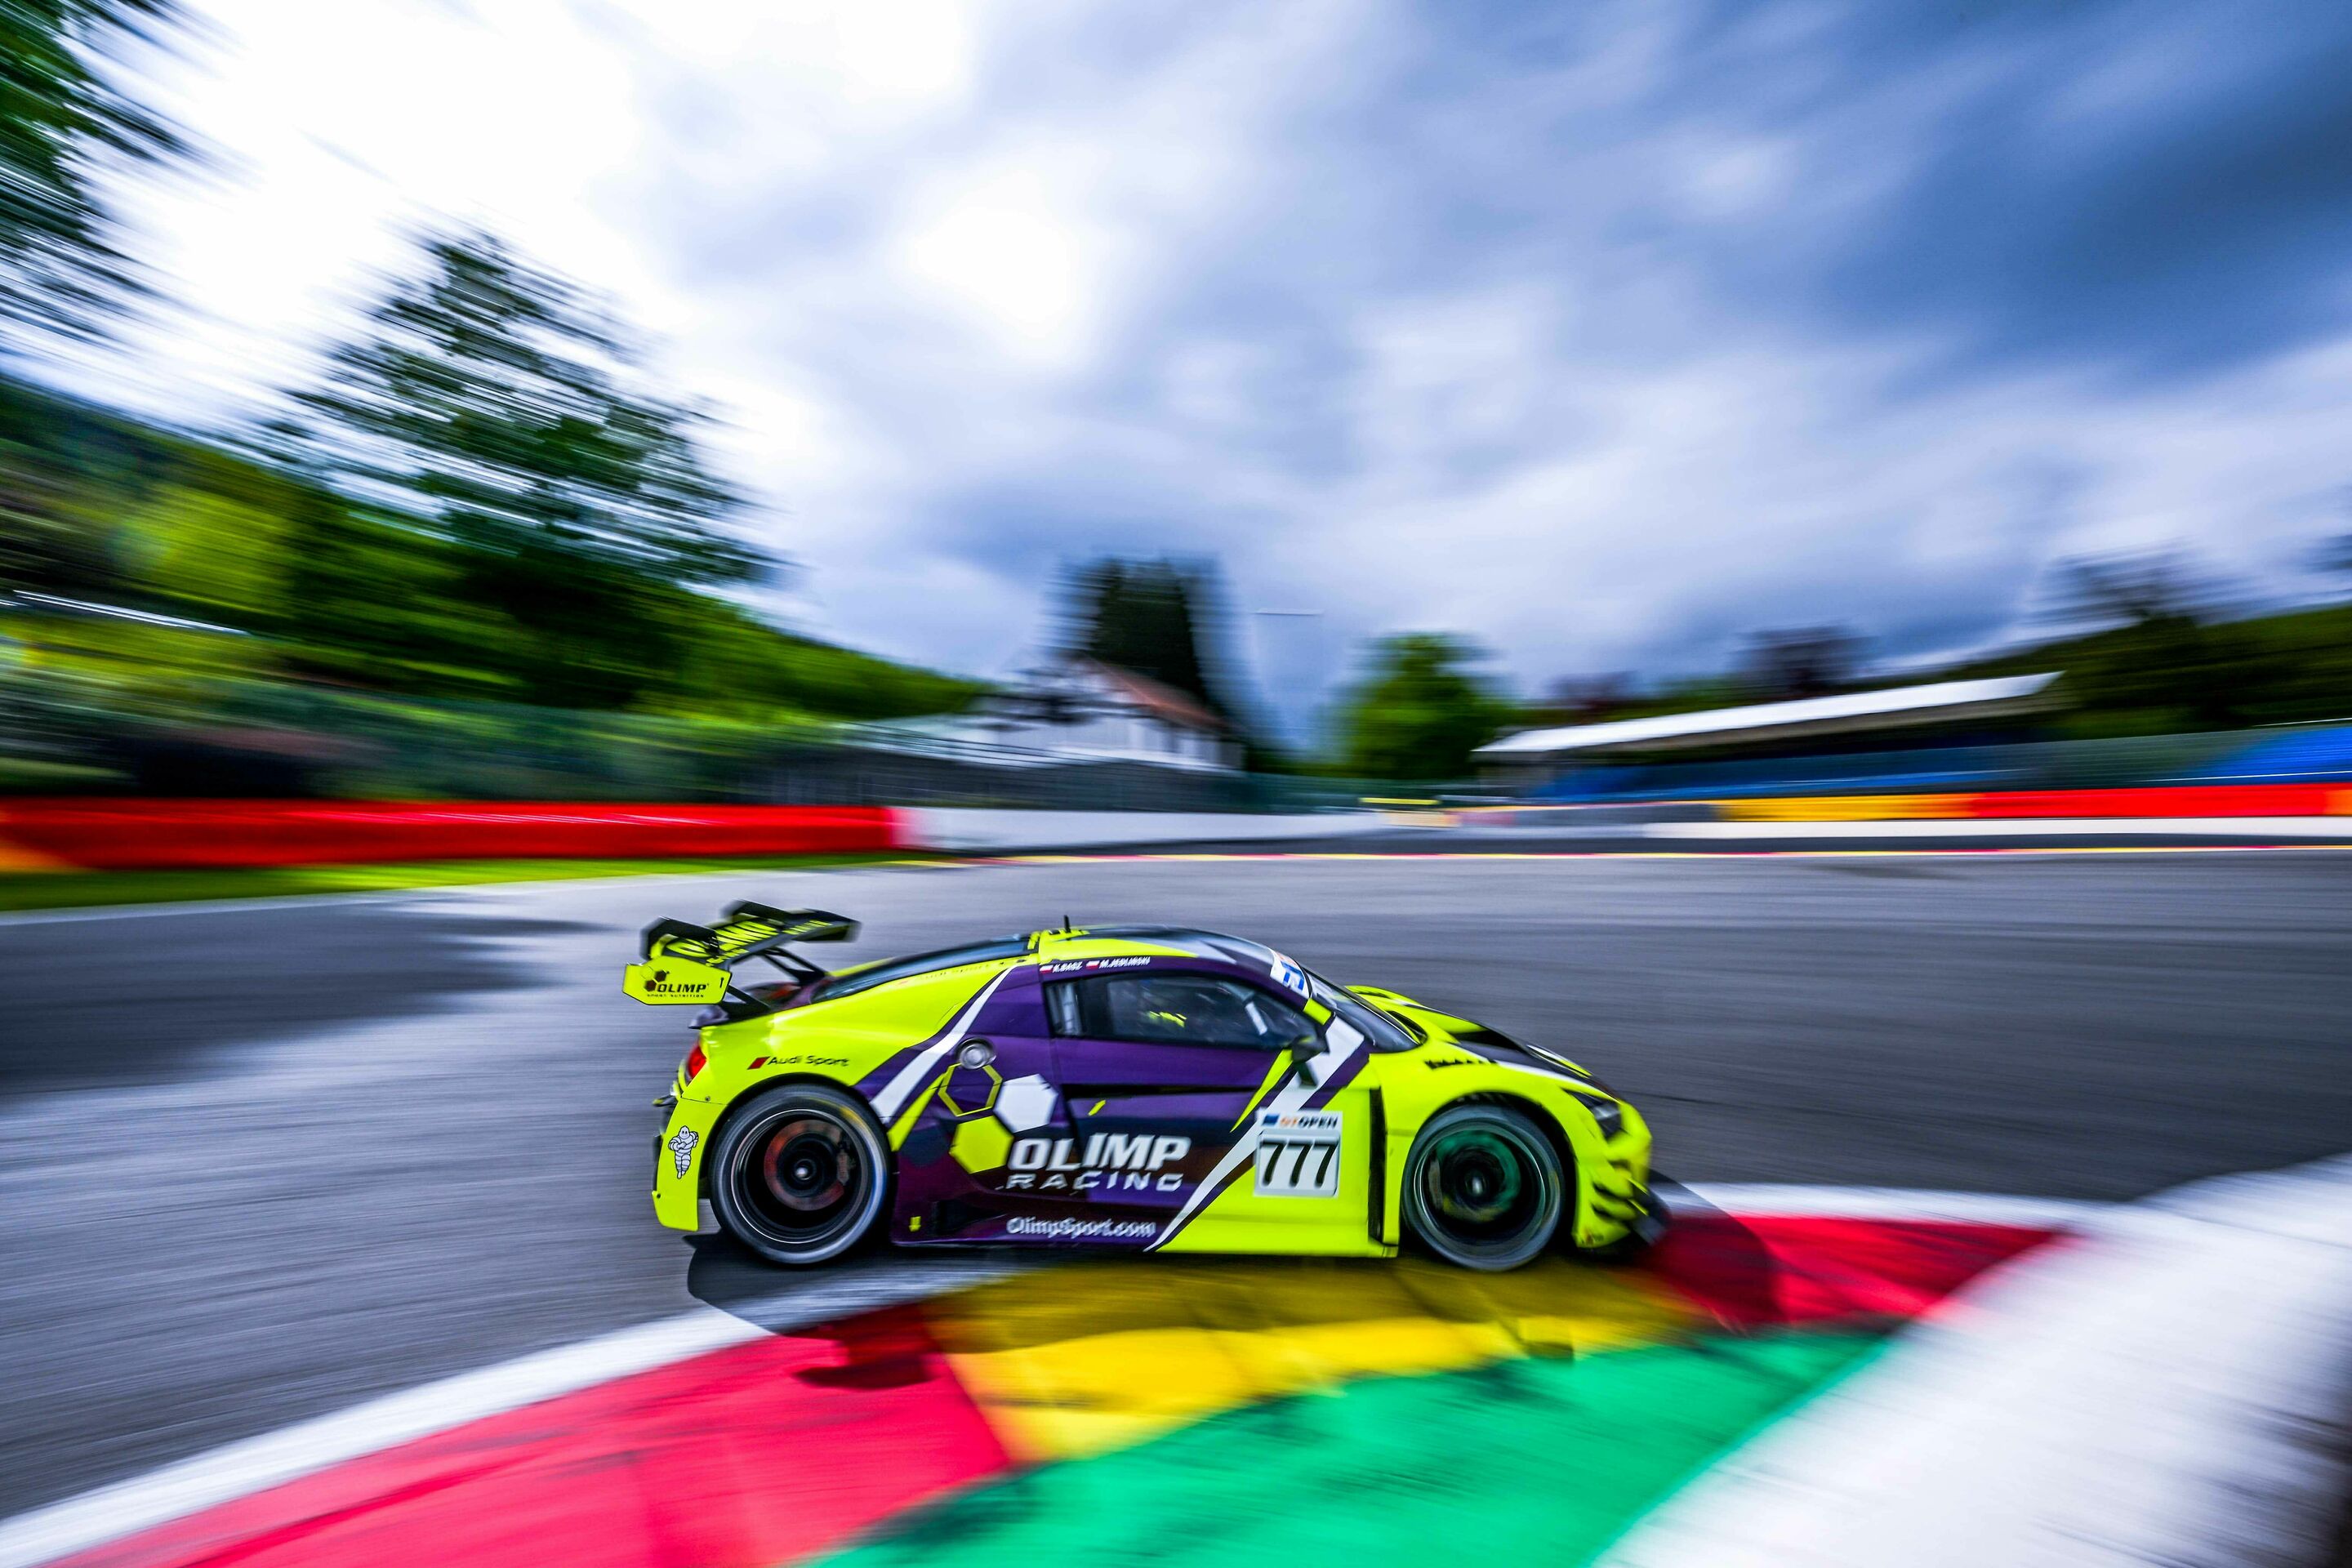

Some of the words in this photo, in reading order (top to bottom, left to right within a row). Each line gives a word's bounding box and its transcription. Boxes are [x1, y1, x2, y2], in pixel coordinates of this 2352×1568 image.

[657, 983, 707, 993] OLIMP
[768, 1056, 803, 1066] Audi
[805, 1055, 849, 1067] Sport
[1007, 1132, 1192, 1172] OLIMP
[1258, 1139, 1339, 1189] 777
[1005, 1170, 1185, 1192] RACING
[1005, 1215, 1157, 1240] OlimpSport.com
